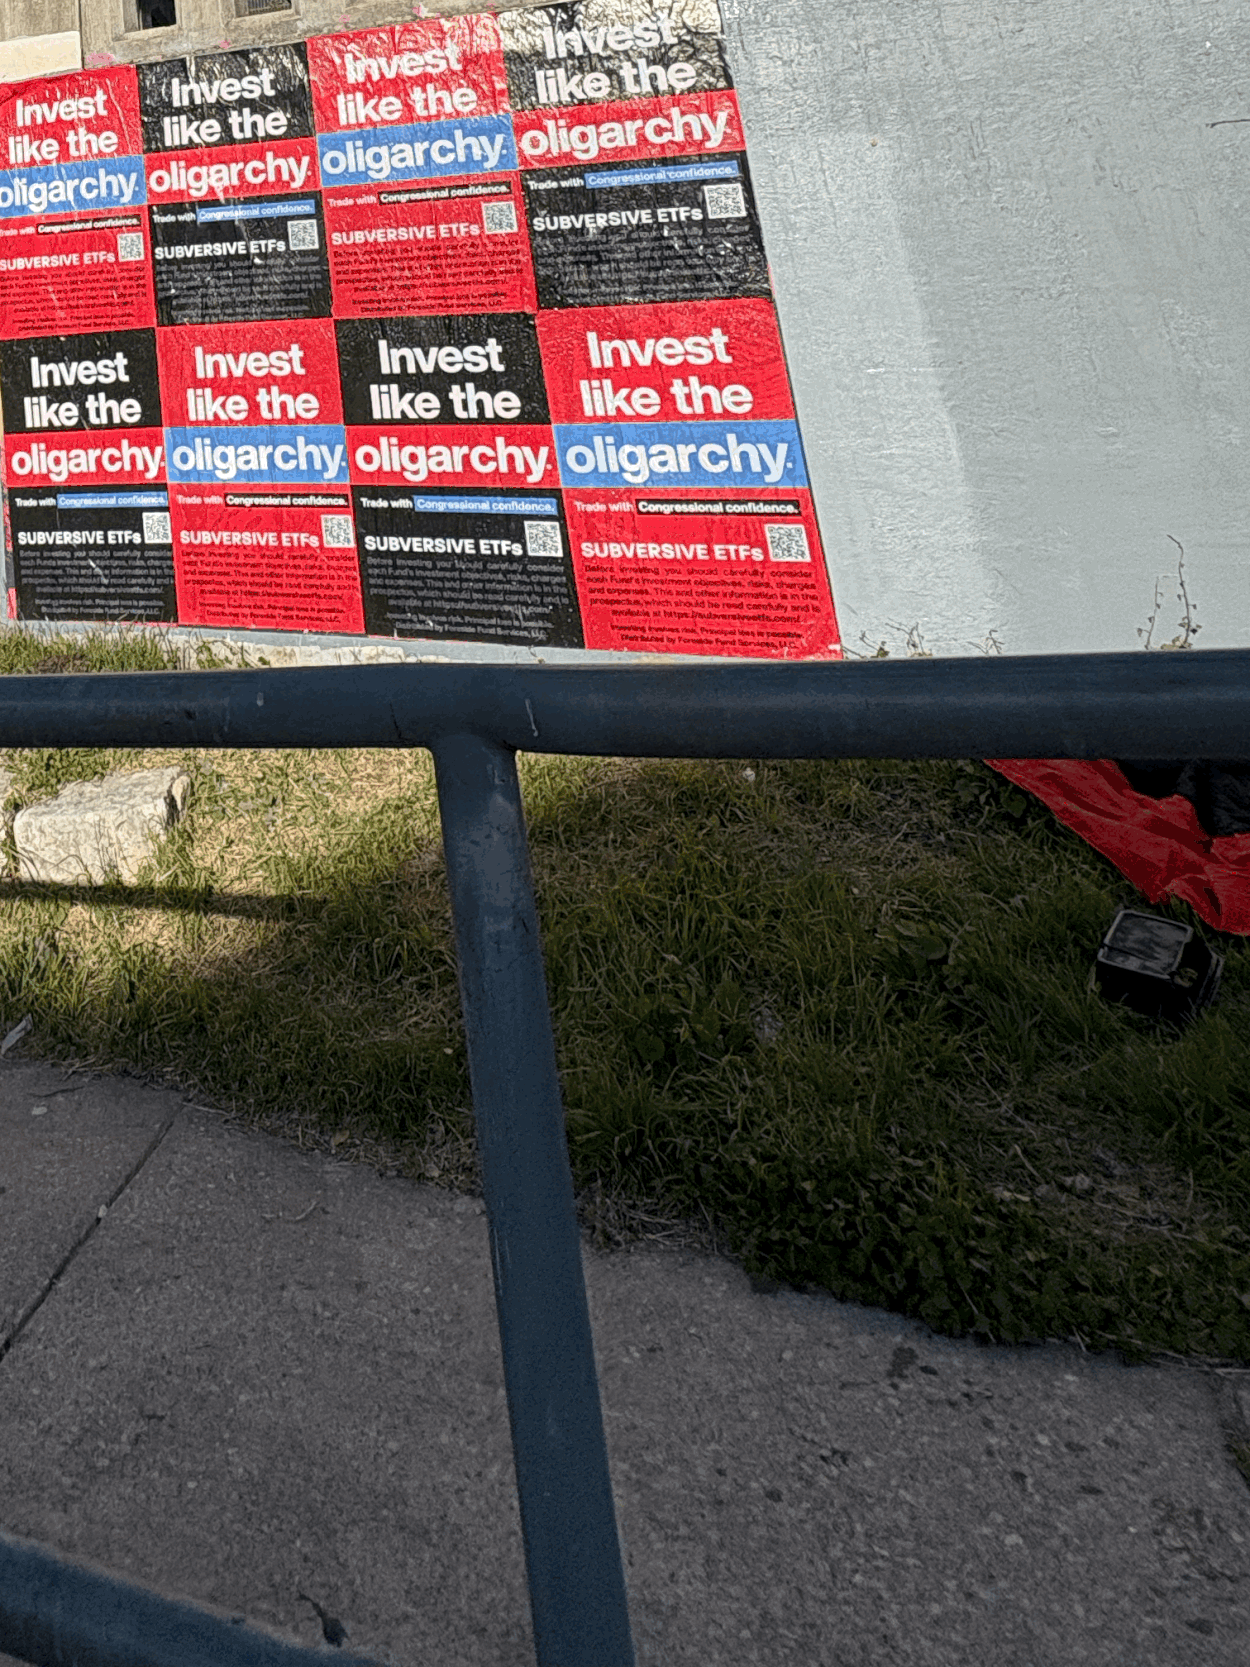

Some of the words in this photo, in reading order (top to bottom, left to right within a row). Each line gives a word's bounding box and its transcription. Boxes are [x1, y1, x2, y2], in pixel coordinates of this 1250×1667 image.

[544, 14, 677, 58] Invest
[345, 43, 458, 82] Invest
[171, 69, 275, 106] Invest
[535, 66, 611, 103] like
[619, 55, 698, 93] the
[16, 89, 106, 127] Invest
[337, 90, 402, 123] like
[411, 82, 478, 116] the
[163, 114, 220, 145] like
[229, 107, 287, 138] the
[9, 133, 58, 164] like
[66, 125, 117, 156] the
[322, 130, 506, 178] oligarchy.
[149, 151, 310, 197] oligarchy.
[528, 180, 556, 191] Trade
[559, 177, 584, 188] with
[668, 167, 734, 179] confidence.
[354, 195, 376, 204] with
[381, 189, 449, 203] Congressional
[451, 186, 509, 197] confidence.
[152, 214, 175, 223] Trade
[177, 212, 196, 221] with
[261, 205, 311, 214] confidence.
[533, 209, 652, 231] SUBVERSIVE
[657, 207, 702, 221] ETFs
[331, 226, 434, 244] SUBVERSIVE
[439, 222, 478, 236] ETFs
[0, 252, 79, 272] SUBVERSIVE
[84, 251, 114, 263] ETFs
[155, 242, 246, 259] SUBVERSIVE
[250, 240, 284, 252] ETFs
[195, 345, 304, 377] Invest
[378, 340, 504, 372] Invest
[587, 329, 732, 367] Invest
[31, 354, 128, 386] Invest
[24, 396, 78, 426] like
[86, 393, 140, 423] the
[187, 389, 248, 420] like
[257, 387, 319, 418] the
[370, 385, 440, 417] like
[449, 383, 521, 417] the
[579, 379, 661, 415] like
[669, 376, 755, 413] the
[173, 438, 346, 477] oligarchy.
[354, 438, 551, 482] oligarchy.
[565, 435, 793, 481] oligarchy.
[15, 498, 35, 506] Trade
[38, 498, 55, 506] with
[59, 496, 115, 507] Congressional
[117, 496, 166, 504] confidence.
[177, 496, 200, 504] Trade
[203, 496, 223, 504] with
[226, 496, 290, 507] Congressional
[292, 496, 348, 505] confidence.
[360, 498, 388, 507] Trade
[390, 499, 412, 508] with
[417, 499, 490, 511] Congressional
[492, 501, 555, 512] confidence.
[574, 502, 605, 512] Trade
[607, 502, 634, 512] with
[638, 502, 723, 515] Congressional
[725, 502, 799, 513] confidence.
[18, 531, 103, 543] SUBVERSIVE
[107, 531, 140, 542] ETFs
[180, 531, 278, 545] SUBVERSIVE
[282, 533, 319, 546] ETFs
[364, 536, 475, 553] SUBVERSIVE
[479, 540, 522, 555] ETFs
[581, 543, 709, 559] SUBVERSIVE
[713, 545, 764, 560] ETFs
